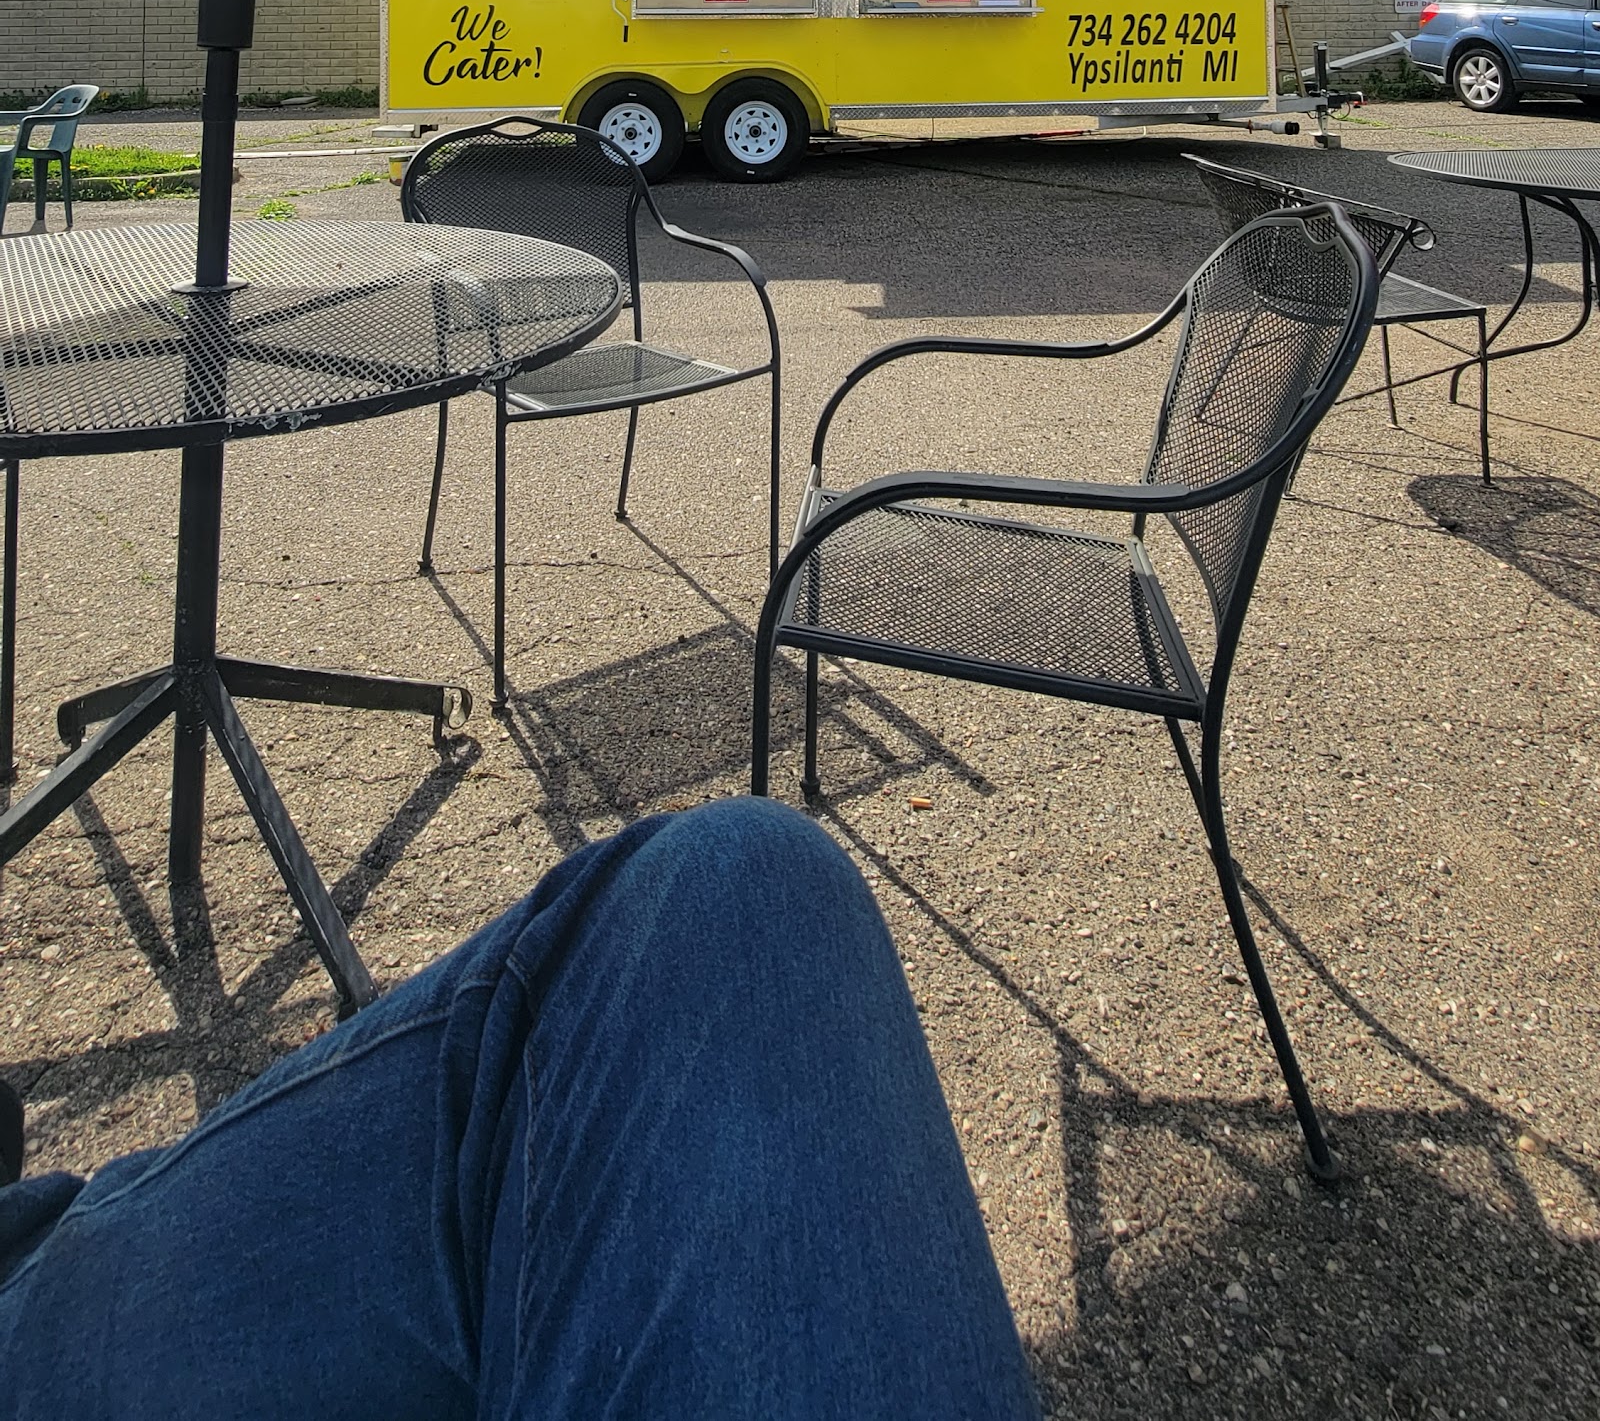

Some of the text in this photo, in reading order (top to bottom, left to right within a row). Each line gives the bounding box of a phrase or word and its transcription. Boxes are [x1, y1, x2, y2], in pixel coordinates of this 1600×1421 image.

[450, 4, 511, 41] We
[1067, 12, 1237, 47] 734 262 4204
[423, 40, 543, 86] Cater!
[1068, 49, 1238, 93] Ypsilanti MI
